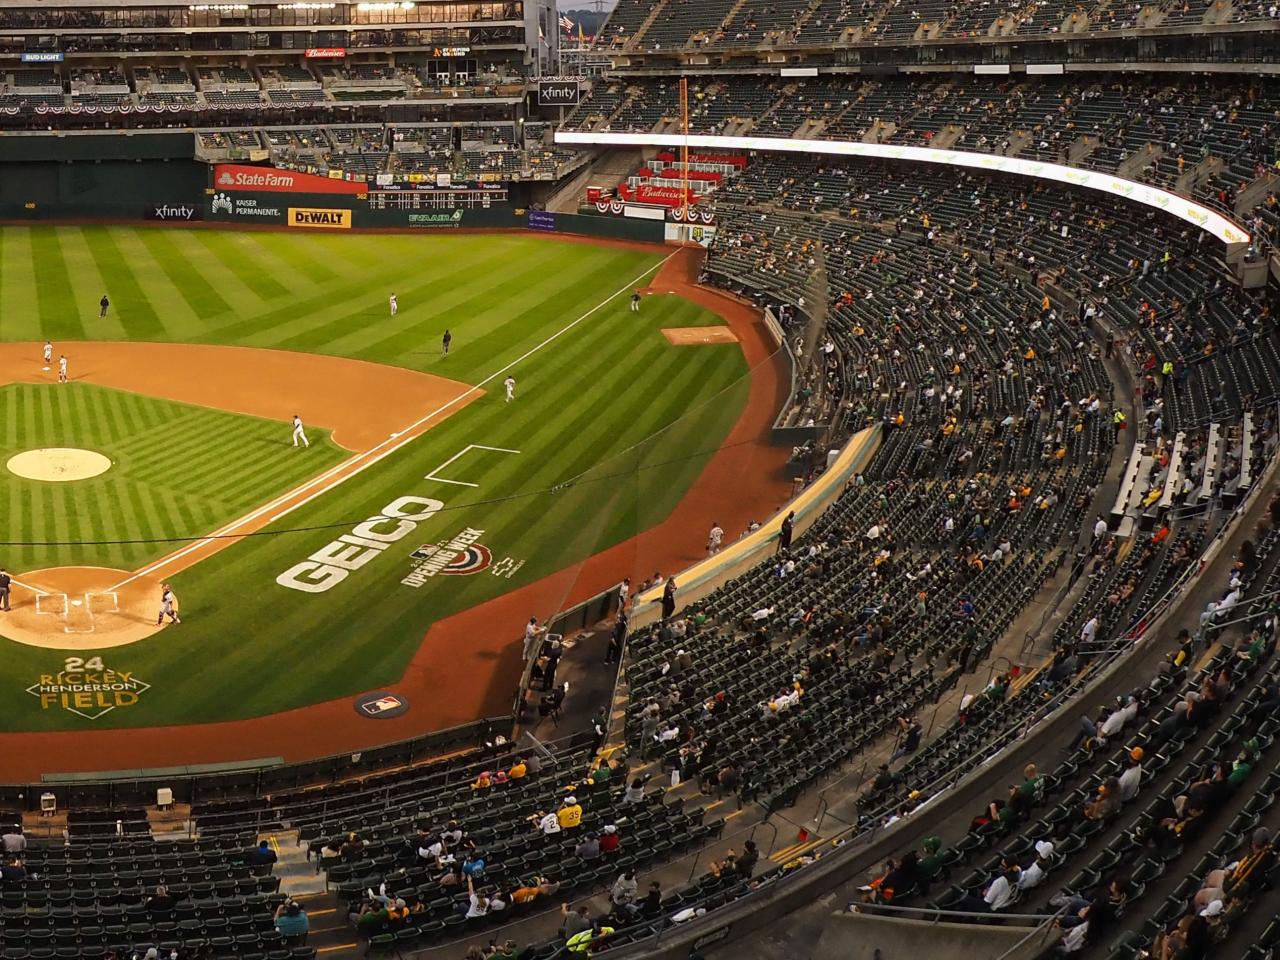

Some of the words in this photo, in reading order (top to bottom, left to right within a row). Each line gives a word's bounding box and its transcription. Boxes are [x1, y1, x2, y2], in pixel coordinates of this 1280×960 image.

[542, 86, 576, 102] xfinity
[155, 204, 194, 219] xfinity
[276, 496, 445, 593] GEICO
[400, 549, 458, 587] OPENING
[444, 527, 485, 551] WEEK
[64, 656, 105, 672] 24
[40, 672, 133, 685] RICKEY
[40, 682, 137, 693] HENDERSON
[40, 691, 139, 710] FIELD
